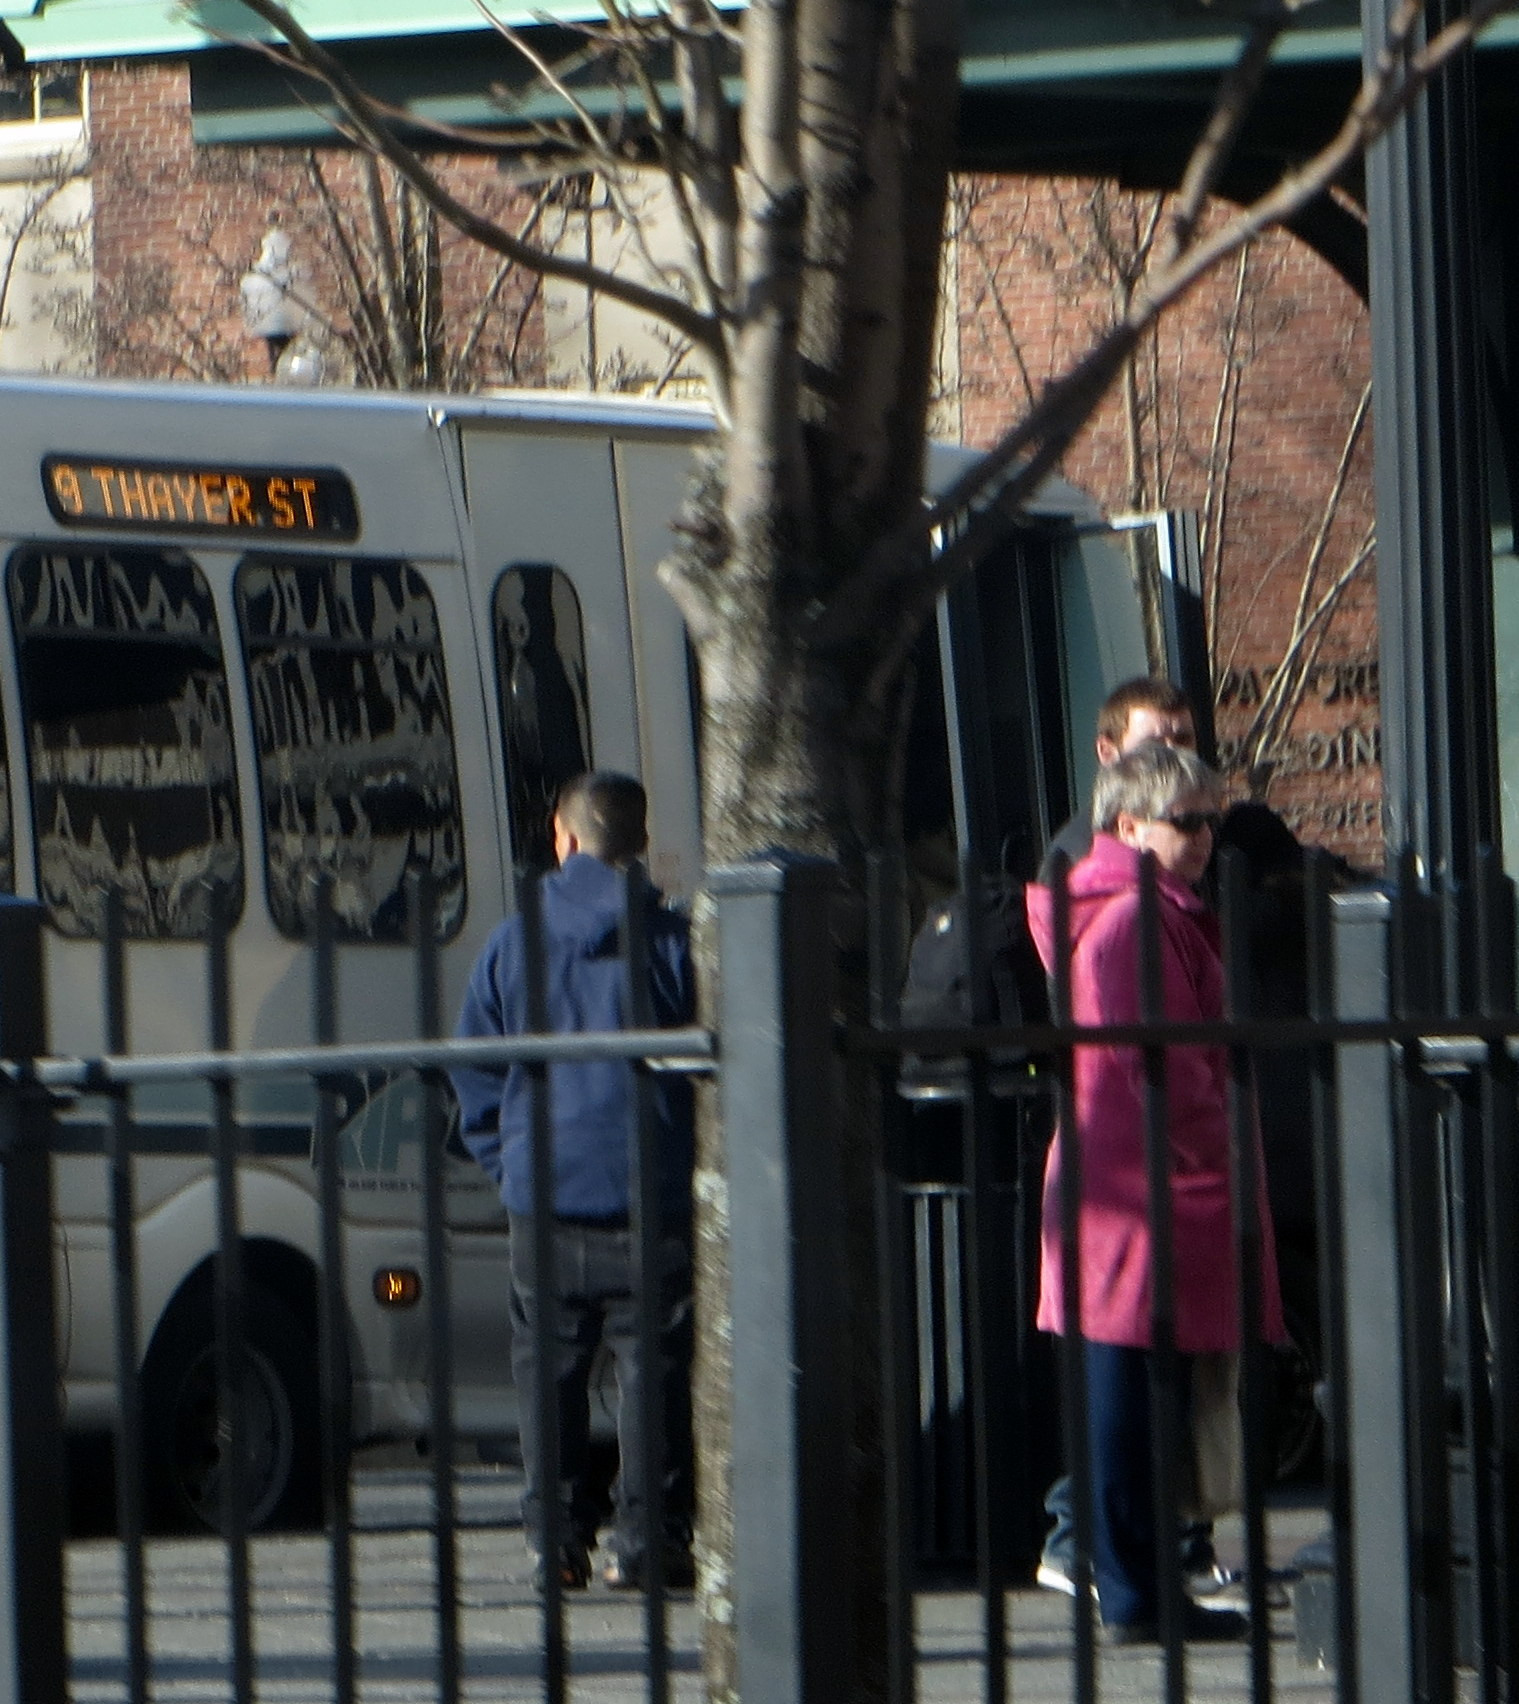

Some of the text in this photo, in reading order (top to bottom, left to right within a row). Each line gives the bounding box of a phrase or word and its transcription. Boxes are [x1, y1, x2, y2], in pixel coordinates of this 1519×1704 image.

[51, 463, 317, 530] 9 THAYER ST
